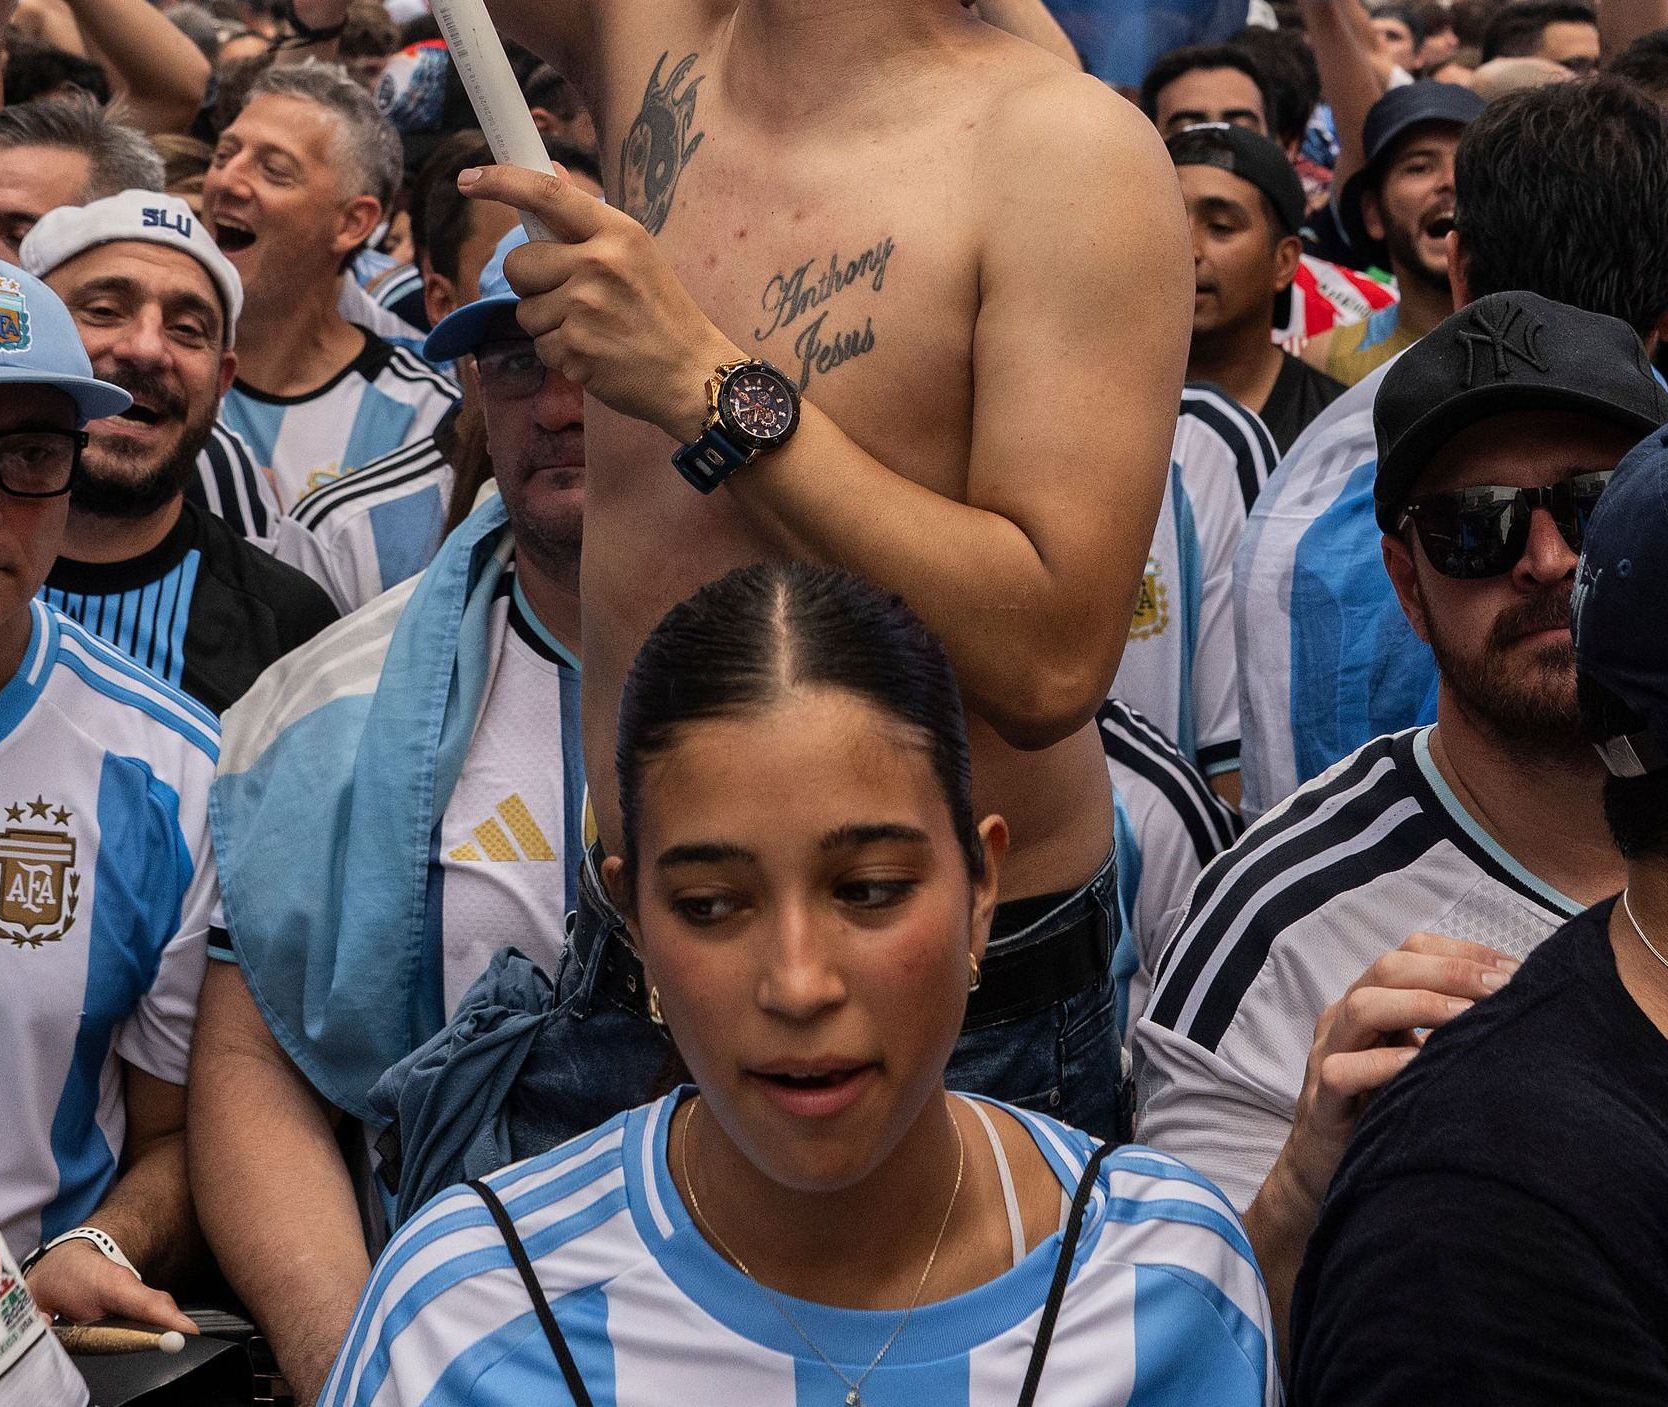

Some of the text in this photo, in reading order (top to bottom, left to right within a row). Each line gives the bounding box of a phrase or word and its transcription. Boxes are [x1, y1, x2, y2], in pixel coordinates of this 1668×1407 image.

[755, 236, 894, 342] Anthony
[795, 318, 875, 394] Jesus
[5, 861, 56, 913] AFA
